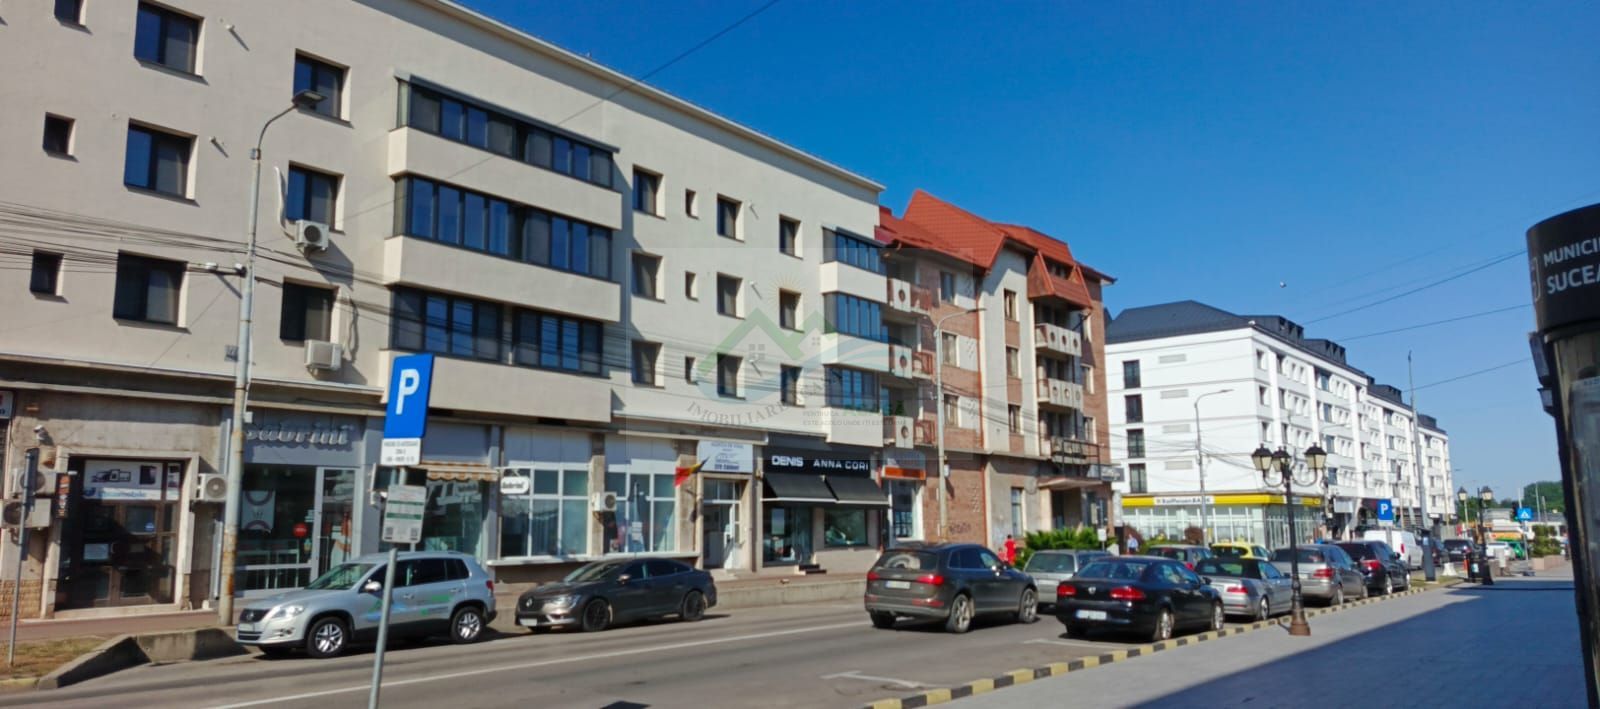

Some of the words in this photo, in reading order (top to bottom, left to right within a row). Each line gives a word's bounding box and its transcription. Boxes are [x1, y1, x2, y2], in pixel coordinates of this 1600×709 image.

[1543, 237, 1600, 267] MUNICI
[396, 369, 420, 415] P
[771, 455, 804, 468] DENIS
[813, 459, 842, 469] ANNA
[845, 460, 869, 471] CORI
[1380, 503, 1388, 515] P
